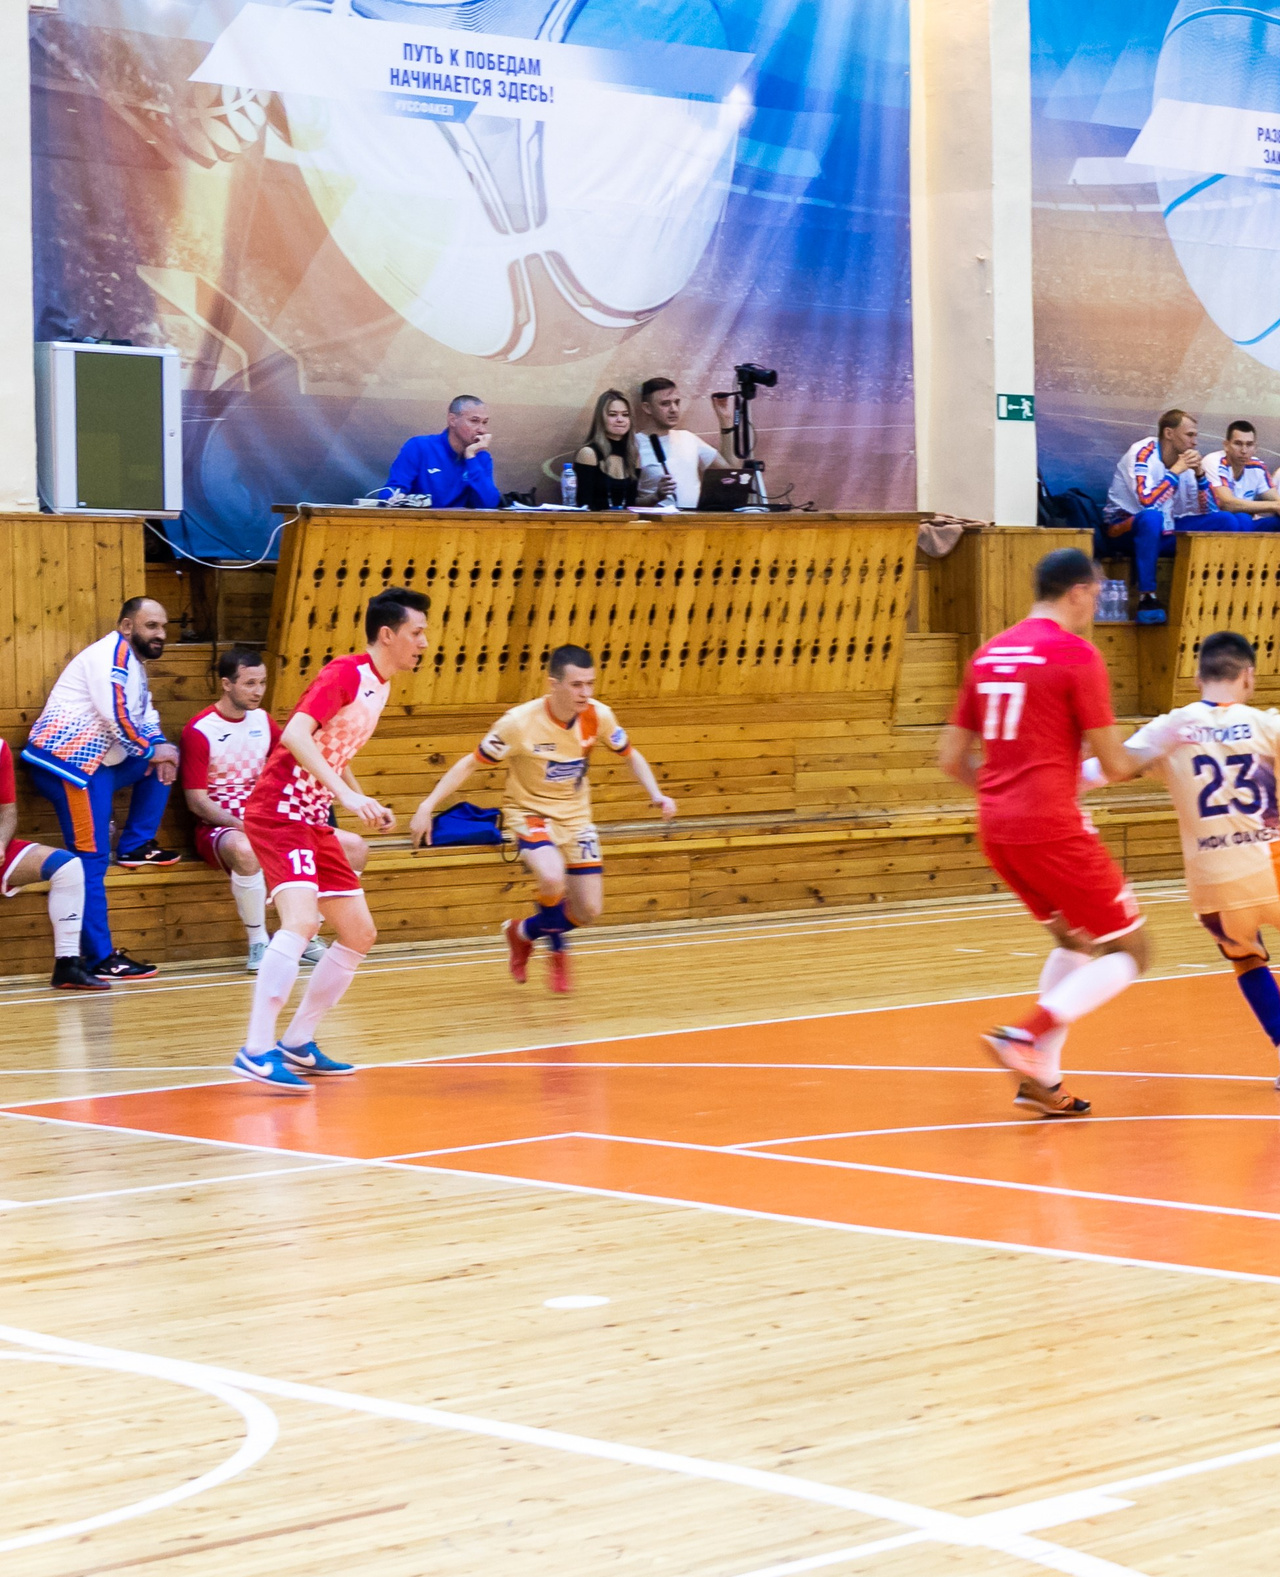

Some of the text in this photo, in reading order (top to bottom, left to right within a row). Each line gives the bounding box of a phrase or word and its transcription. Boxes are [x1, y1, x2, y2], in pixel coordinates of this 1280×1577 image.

[403, 43, 541, 77] ПУТЬ К ПОБЕДАМ
[390, 68, 554, 104] НАЧИНАЕТСЯ ЗДЕСЬ!
[976, 682, 1027, 741] 77
[1192, 753, 1262, 818] 23
[288, 848, 316, 875] 13
